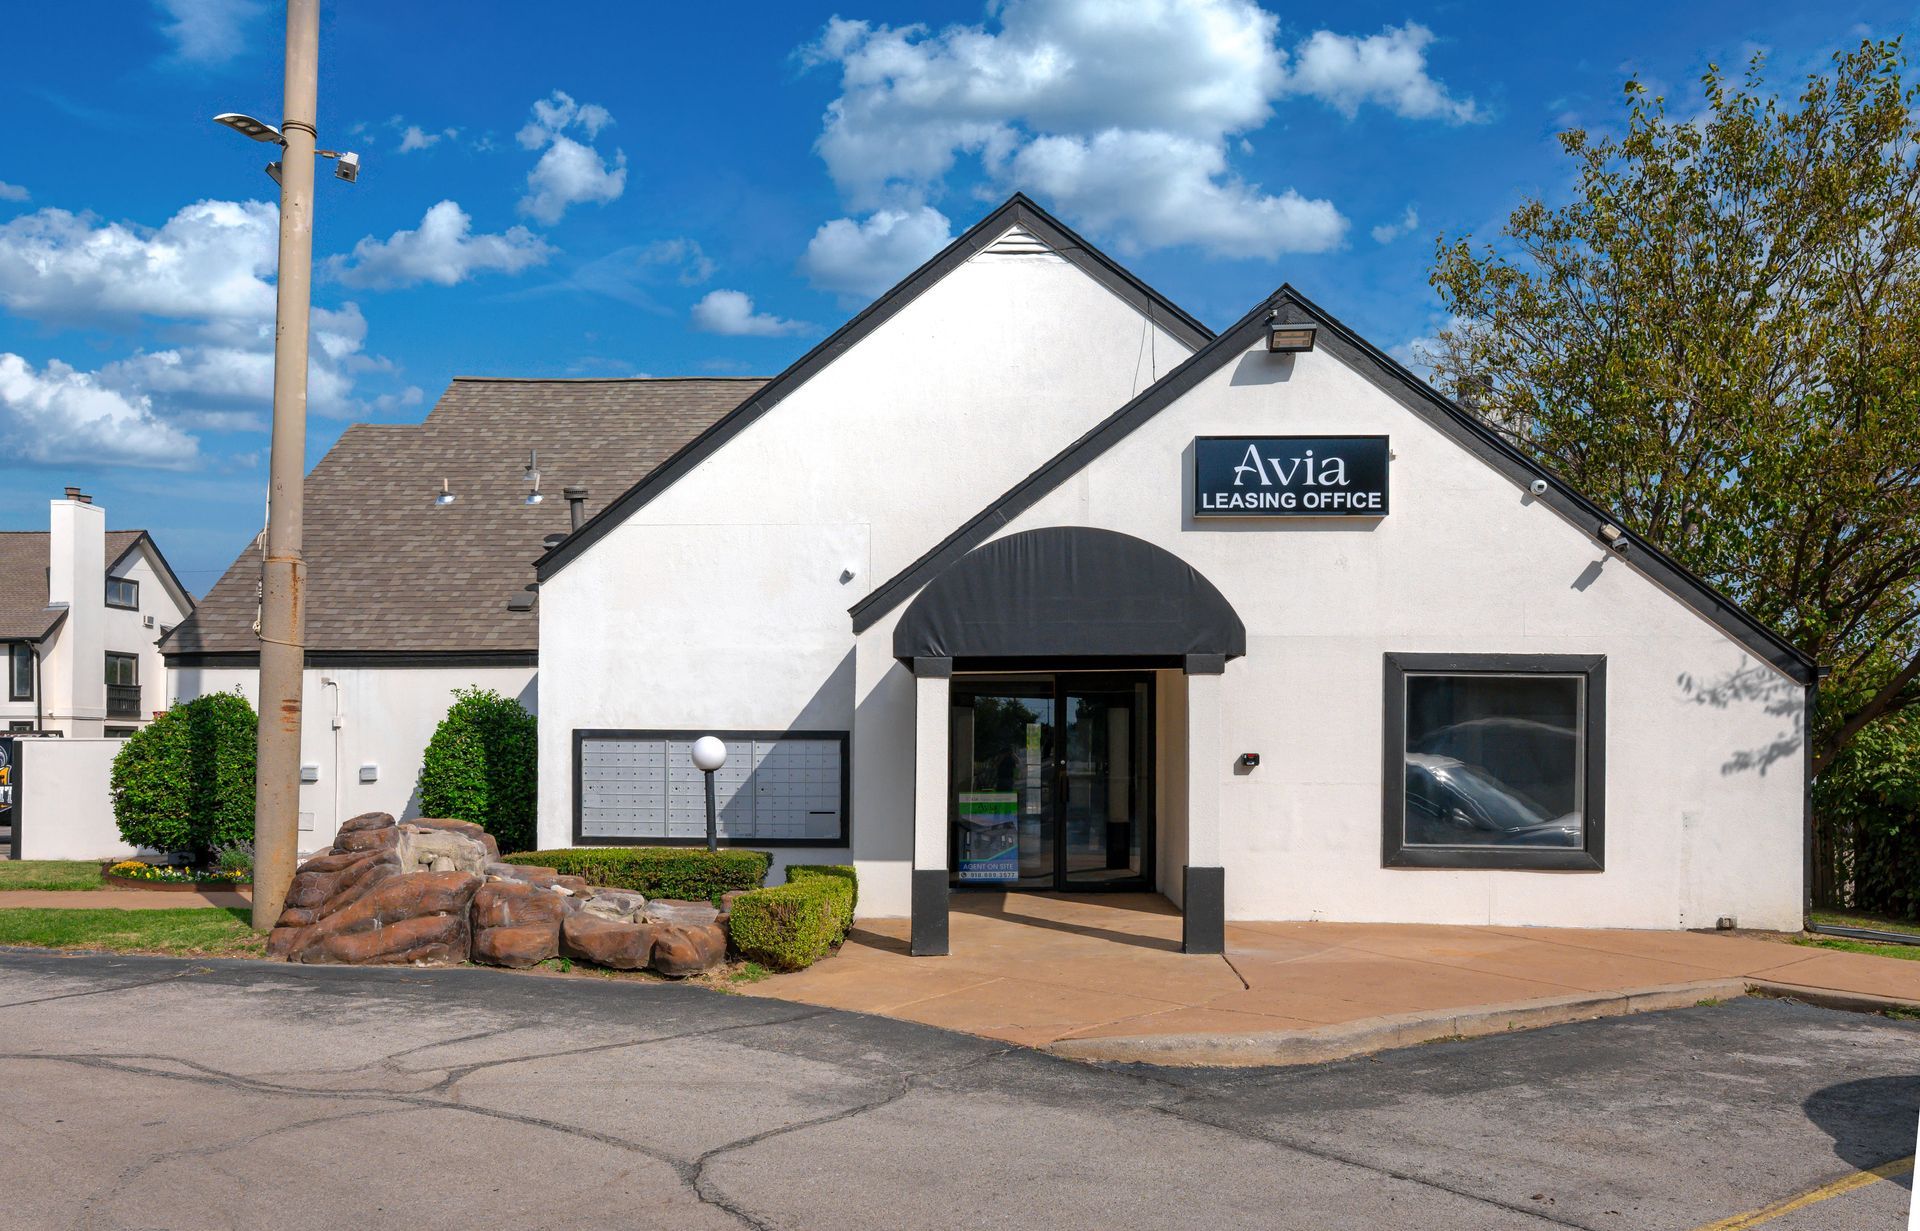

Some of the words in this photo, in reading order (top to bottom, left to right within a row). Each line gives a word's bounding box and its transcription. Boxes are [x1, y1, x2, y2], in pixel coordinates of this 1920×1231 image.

[1233, 443, 1350, 486] Avia
[1202, 492, 1296, 509] LEASING
[1303, 492, 1382, 509] OFFICE
